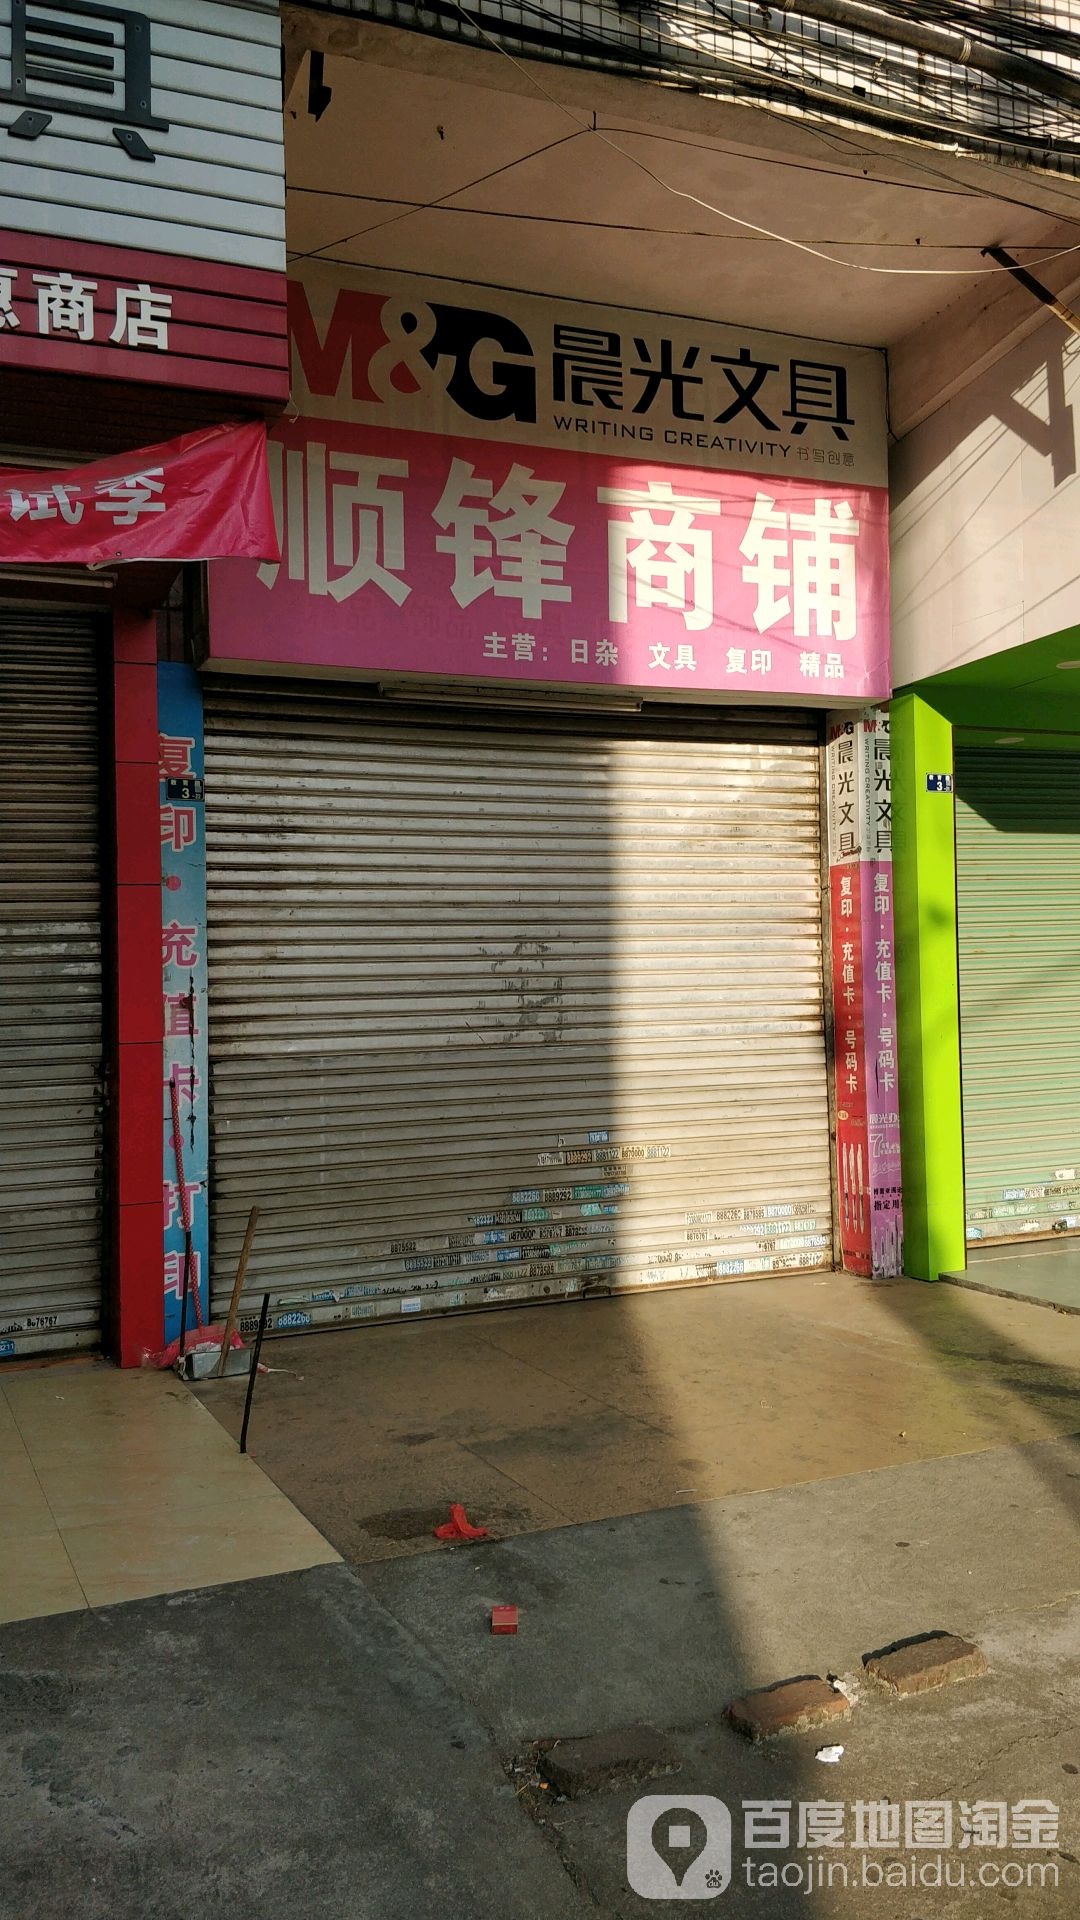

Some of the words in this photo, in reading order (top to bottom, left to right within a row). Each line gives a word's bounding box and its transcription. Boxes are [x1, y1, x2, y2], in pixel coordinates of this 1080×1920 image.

[0, 0, 170, 163] 具
[553, 323, 855, 442] 晨光文具
[553, 415, 654, 441] WRITING
[664, 430, 791, 458] CREATIVITY
[256, 440, 860, 642] 顺锋商铺
[648, 641, 698, 672] 文具
[725, 647, 772, 676] 复印
[800, 650, 845, 679] 精品
[864, 738, 872, 775] WRITING
[837, 740, 857, 856] 晨光文具
[240, 1318, 273, 1332] 888992
